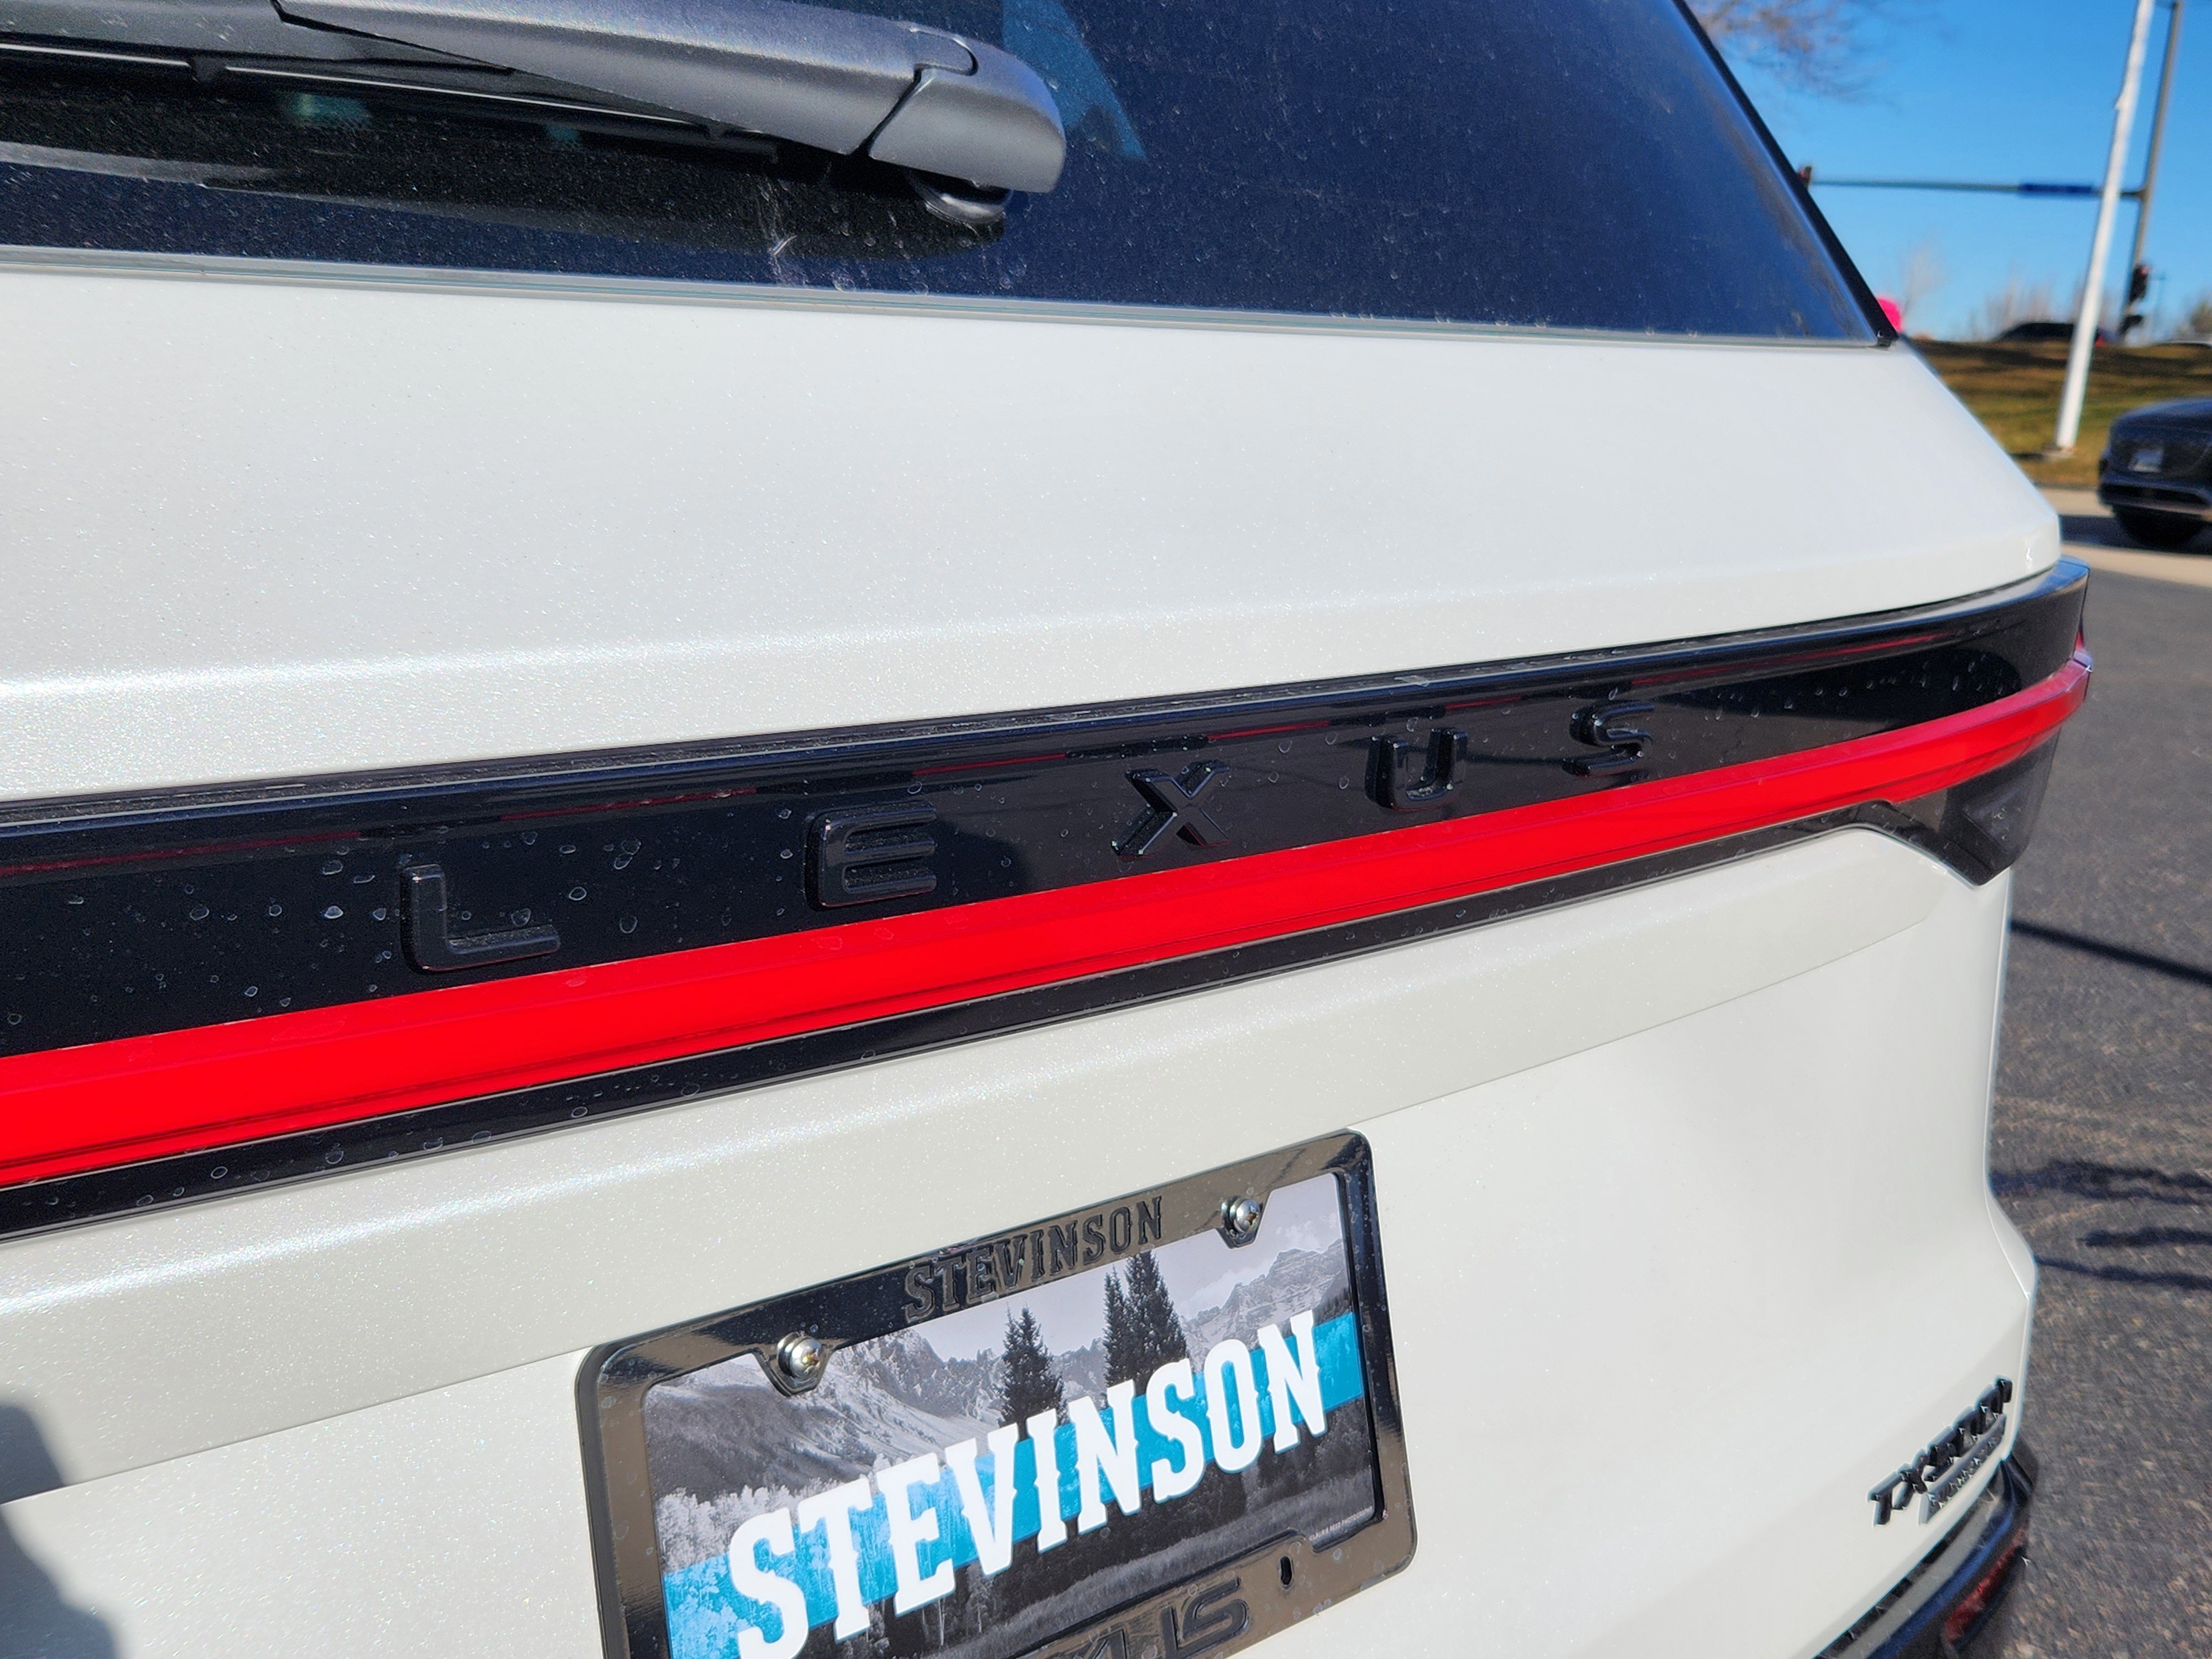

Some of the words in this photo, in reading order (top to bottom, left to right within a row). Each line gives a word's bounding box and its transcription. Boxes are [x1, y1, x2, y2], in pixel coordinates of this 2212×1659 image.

[399, 700, 1655, 972] LEXUS
[904, 1195, 1162, 1323] STEVINSON
[728, 1309, 1327, 1659] STEVINSON
